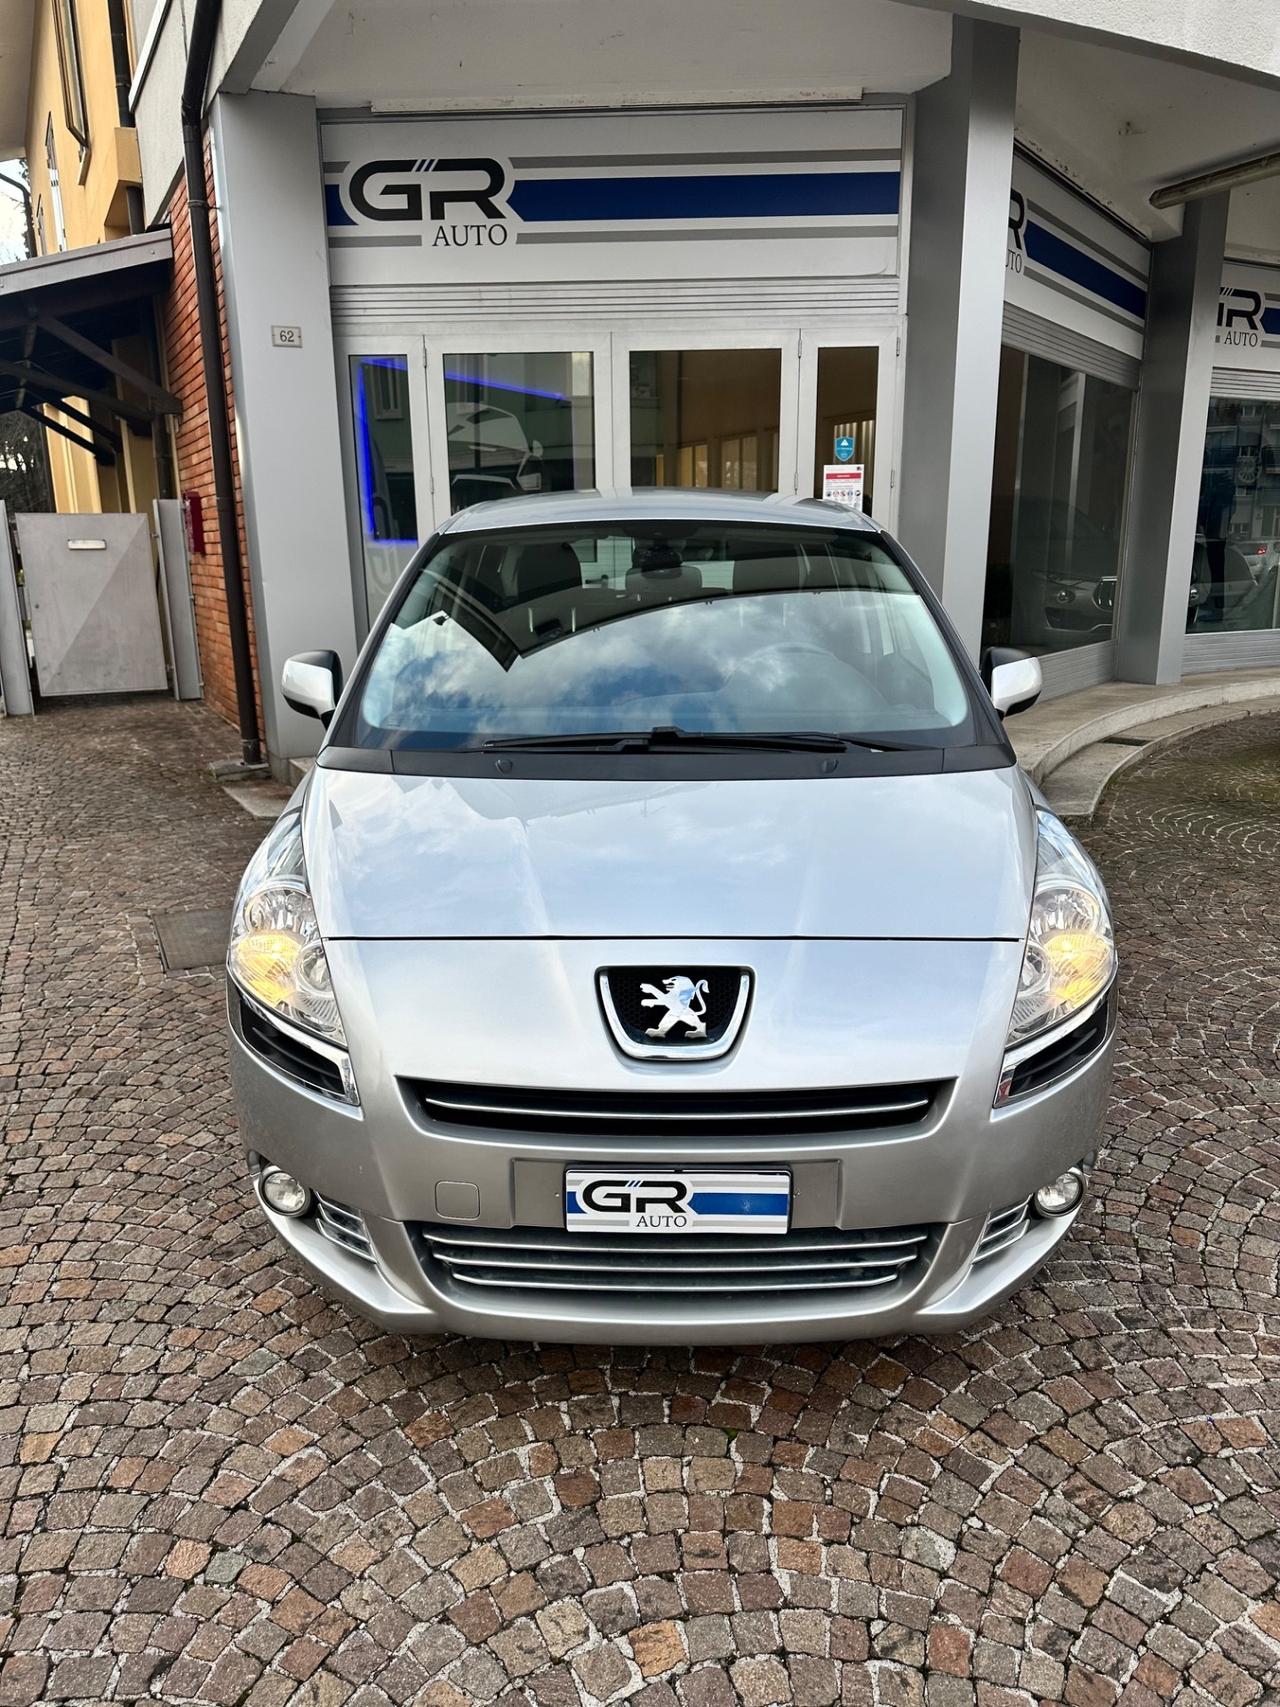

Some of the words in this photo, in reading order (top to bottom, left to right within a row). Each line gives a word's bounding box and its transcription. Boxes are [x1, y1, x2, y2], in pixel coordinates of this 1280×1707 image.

[349, 157, 507, 221] GR
[432, 224, 508, 247] AUTO
[279, 329, 295, 343] 62
[1224, 331, 1258, 347] AUTO
[582, 1179, 687, 1214] GR
[636, 1215, 687, 1228] AUTO
